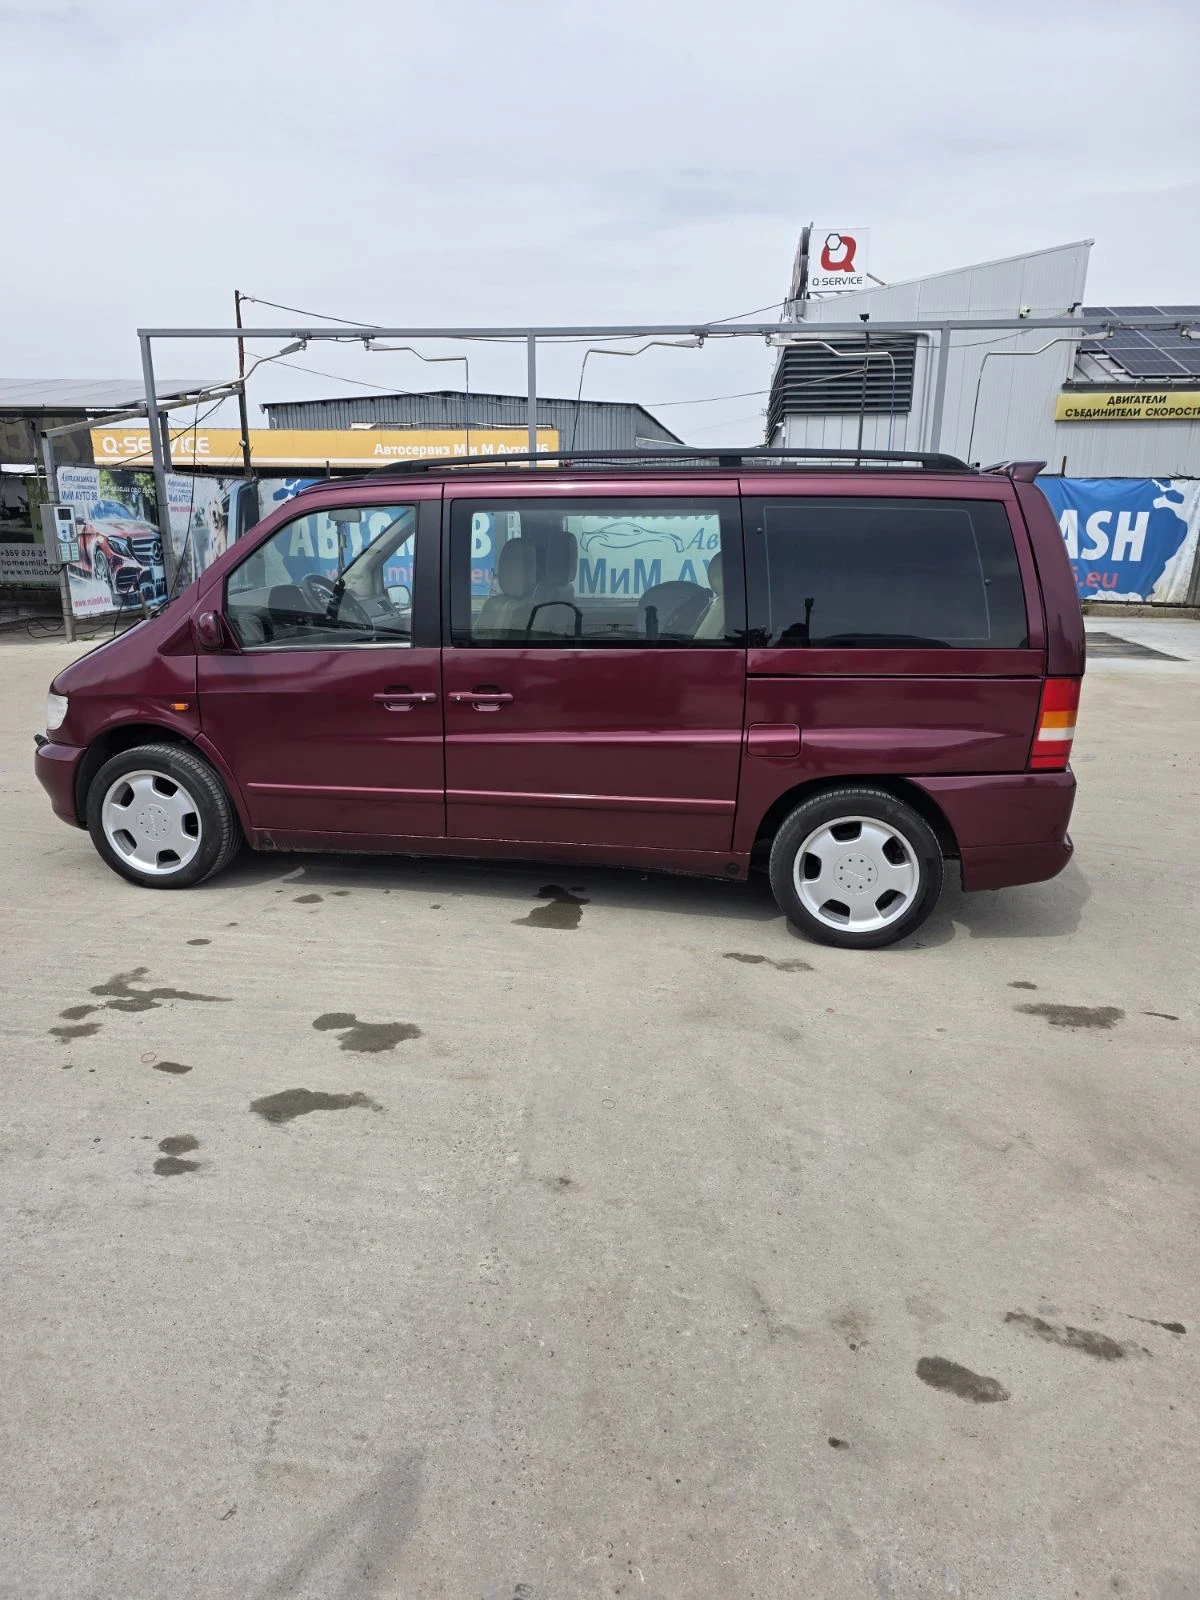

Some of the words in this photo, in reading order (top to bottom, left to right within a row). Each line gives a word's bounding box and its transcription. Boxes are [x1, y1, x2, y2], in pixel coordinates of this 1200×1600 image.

[1107, 395, 1167, 406] ДВИГАТЕЛИ
[1065, 408, 1141, 418] СЪЕДИНИТЕЛИ
[374, 443, 450, 457] Автосервиз
